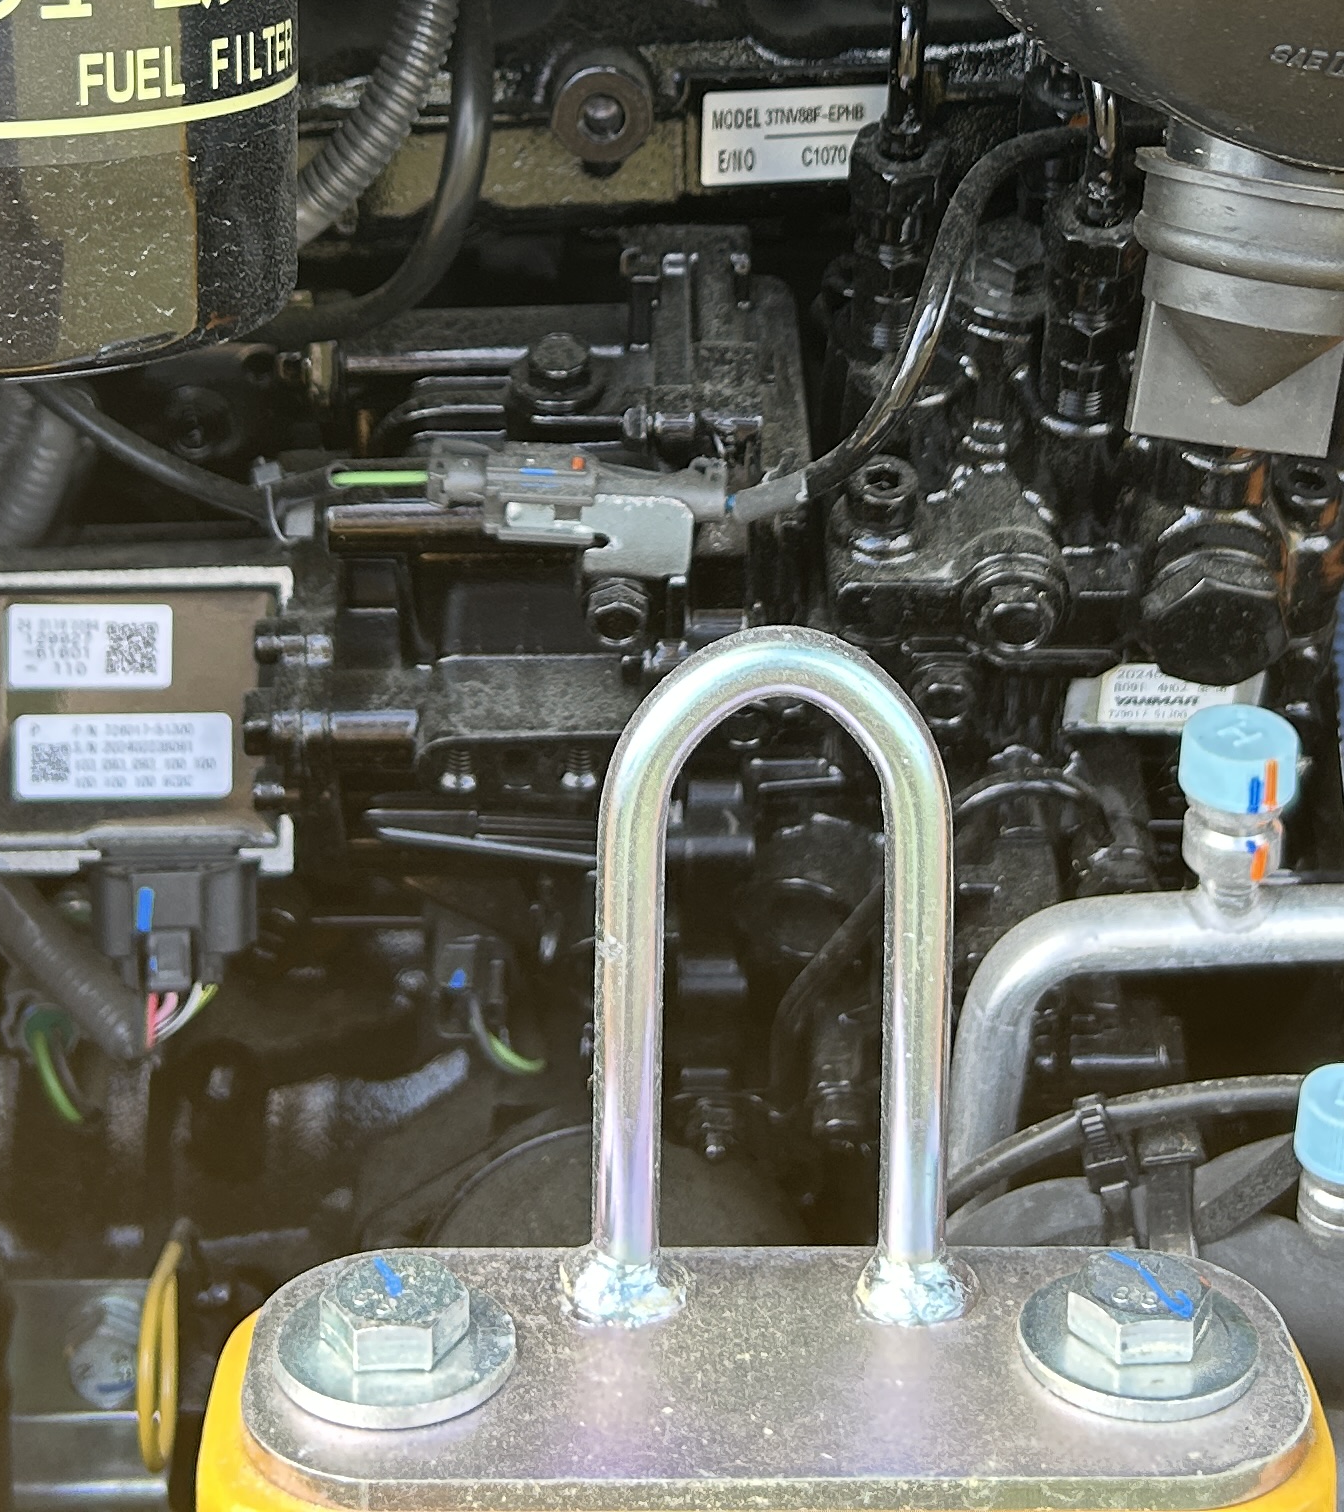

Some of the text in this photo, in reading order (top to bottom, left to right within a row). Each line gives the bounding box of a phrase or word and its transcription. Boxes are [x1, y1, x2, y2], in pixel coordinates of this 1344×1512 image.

[77, 18, 293, 106] FUEL FILTER
[712, 107, 761, 130] MODEL
[801, 145, 847, 168] C1070
